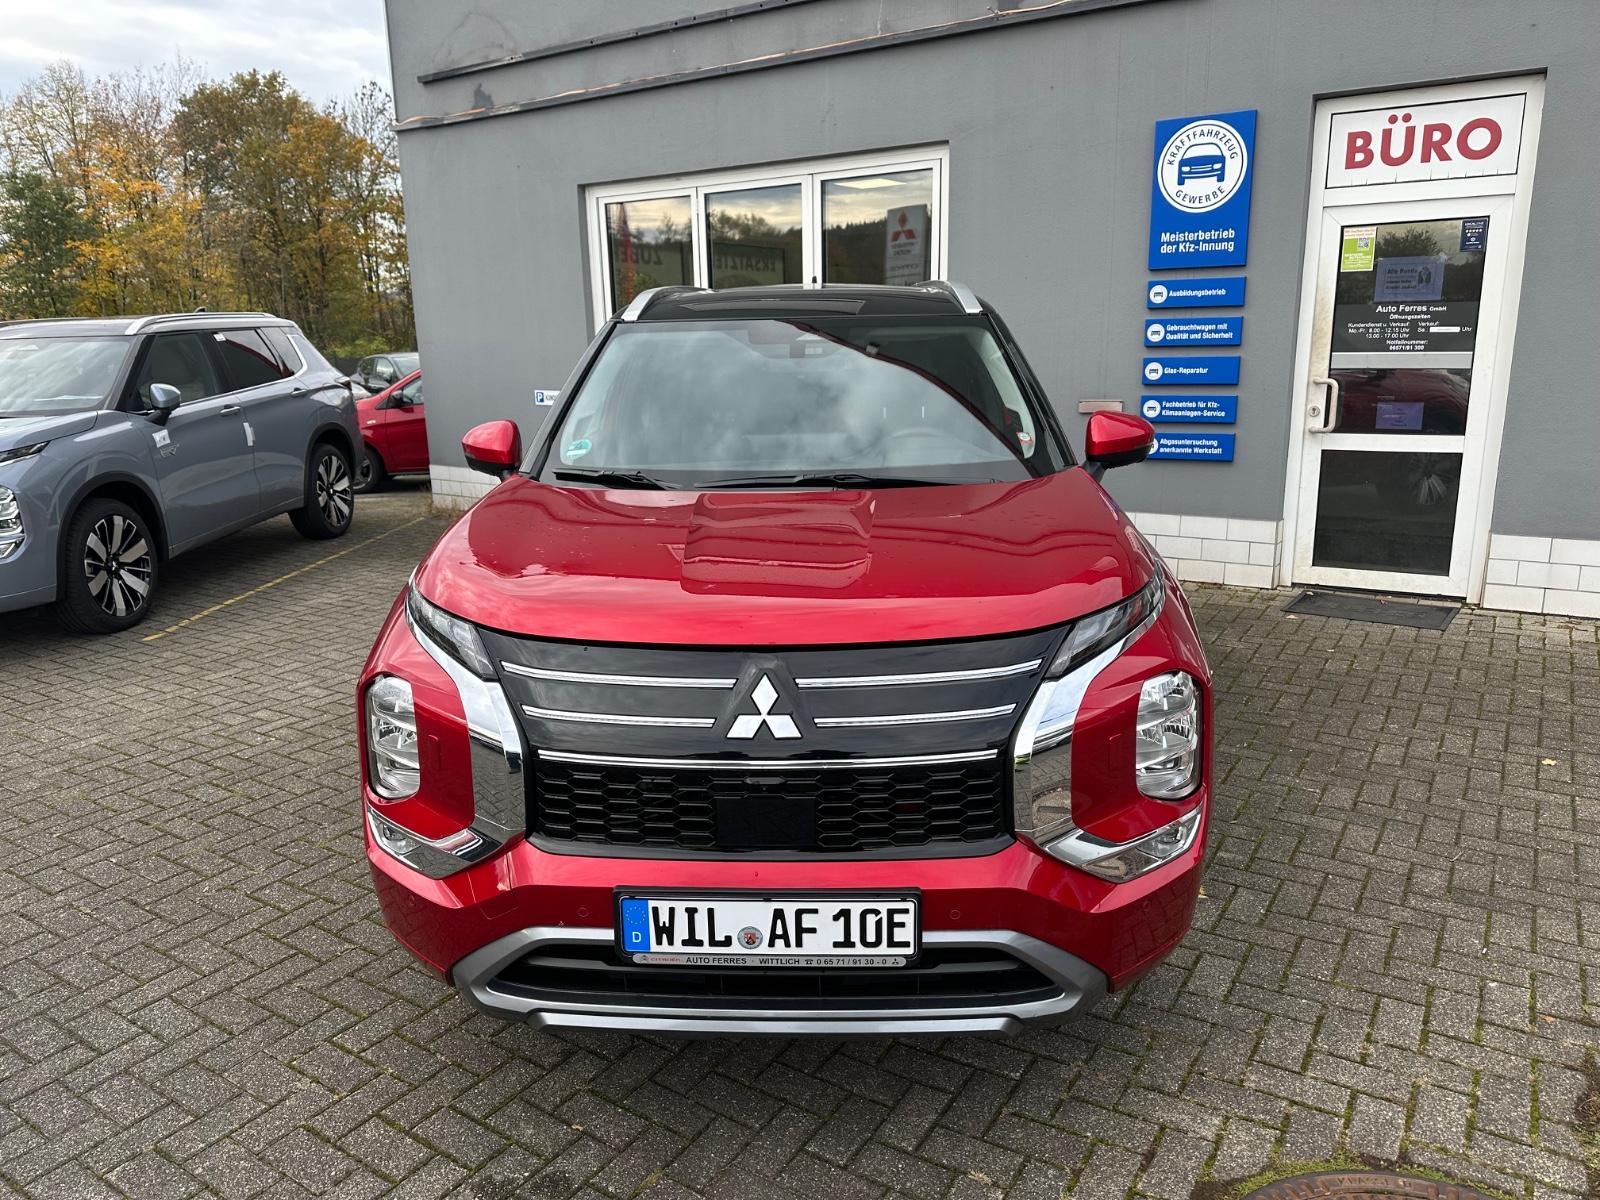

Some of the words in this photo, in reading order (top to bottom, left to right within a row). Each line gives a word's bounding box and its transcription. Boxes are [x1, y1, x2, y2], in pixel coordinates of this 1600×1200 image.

[1166, 128, 1238, 166] KRAFTFAHRZEUG
[1344, 113, 1502, 170] BÜRO
[1175, 186, 1226, 204] GEWERBE
[1160, 228, 1235, 242] Meisterbetrieb
[1160, 244, 1176, 254] der
[1178, 241, 1234, 253] Kfz-Innung
[1168, 288, 1226, 297] Ausbildungsbetrieb
[1160, 438, 1218, 446] Abgasuntersuchung
[652, 906, 732, 947] WIL
[768, 908, 819, 948] AF
[832, 908, 911, 948] 10E
[632, 932, 642, 942] D
